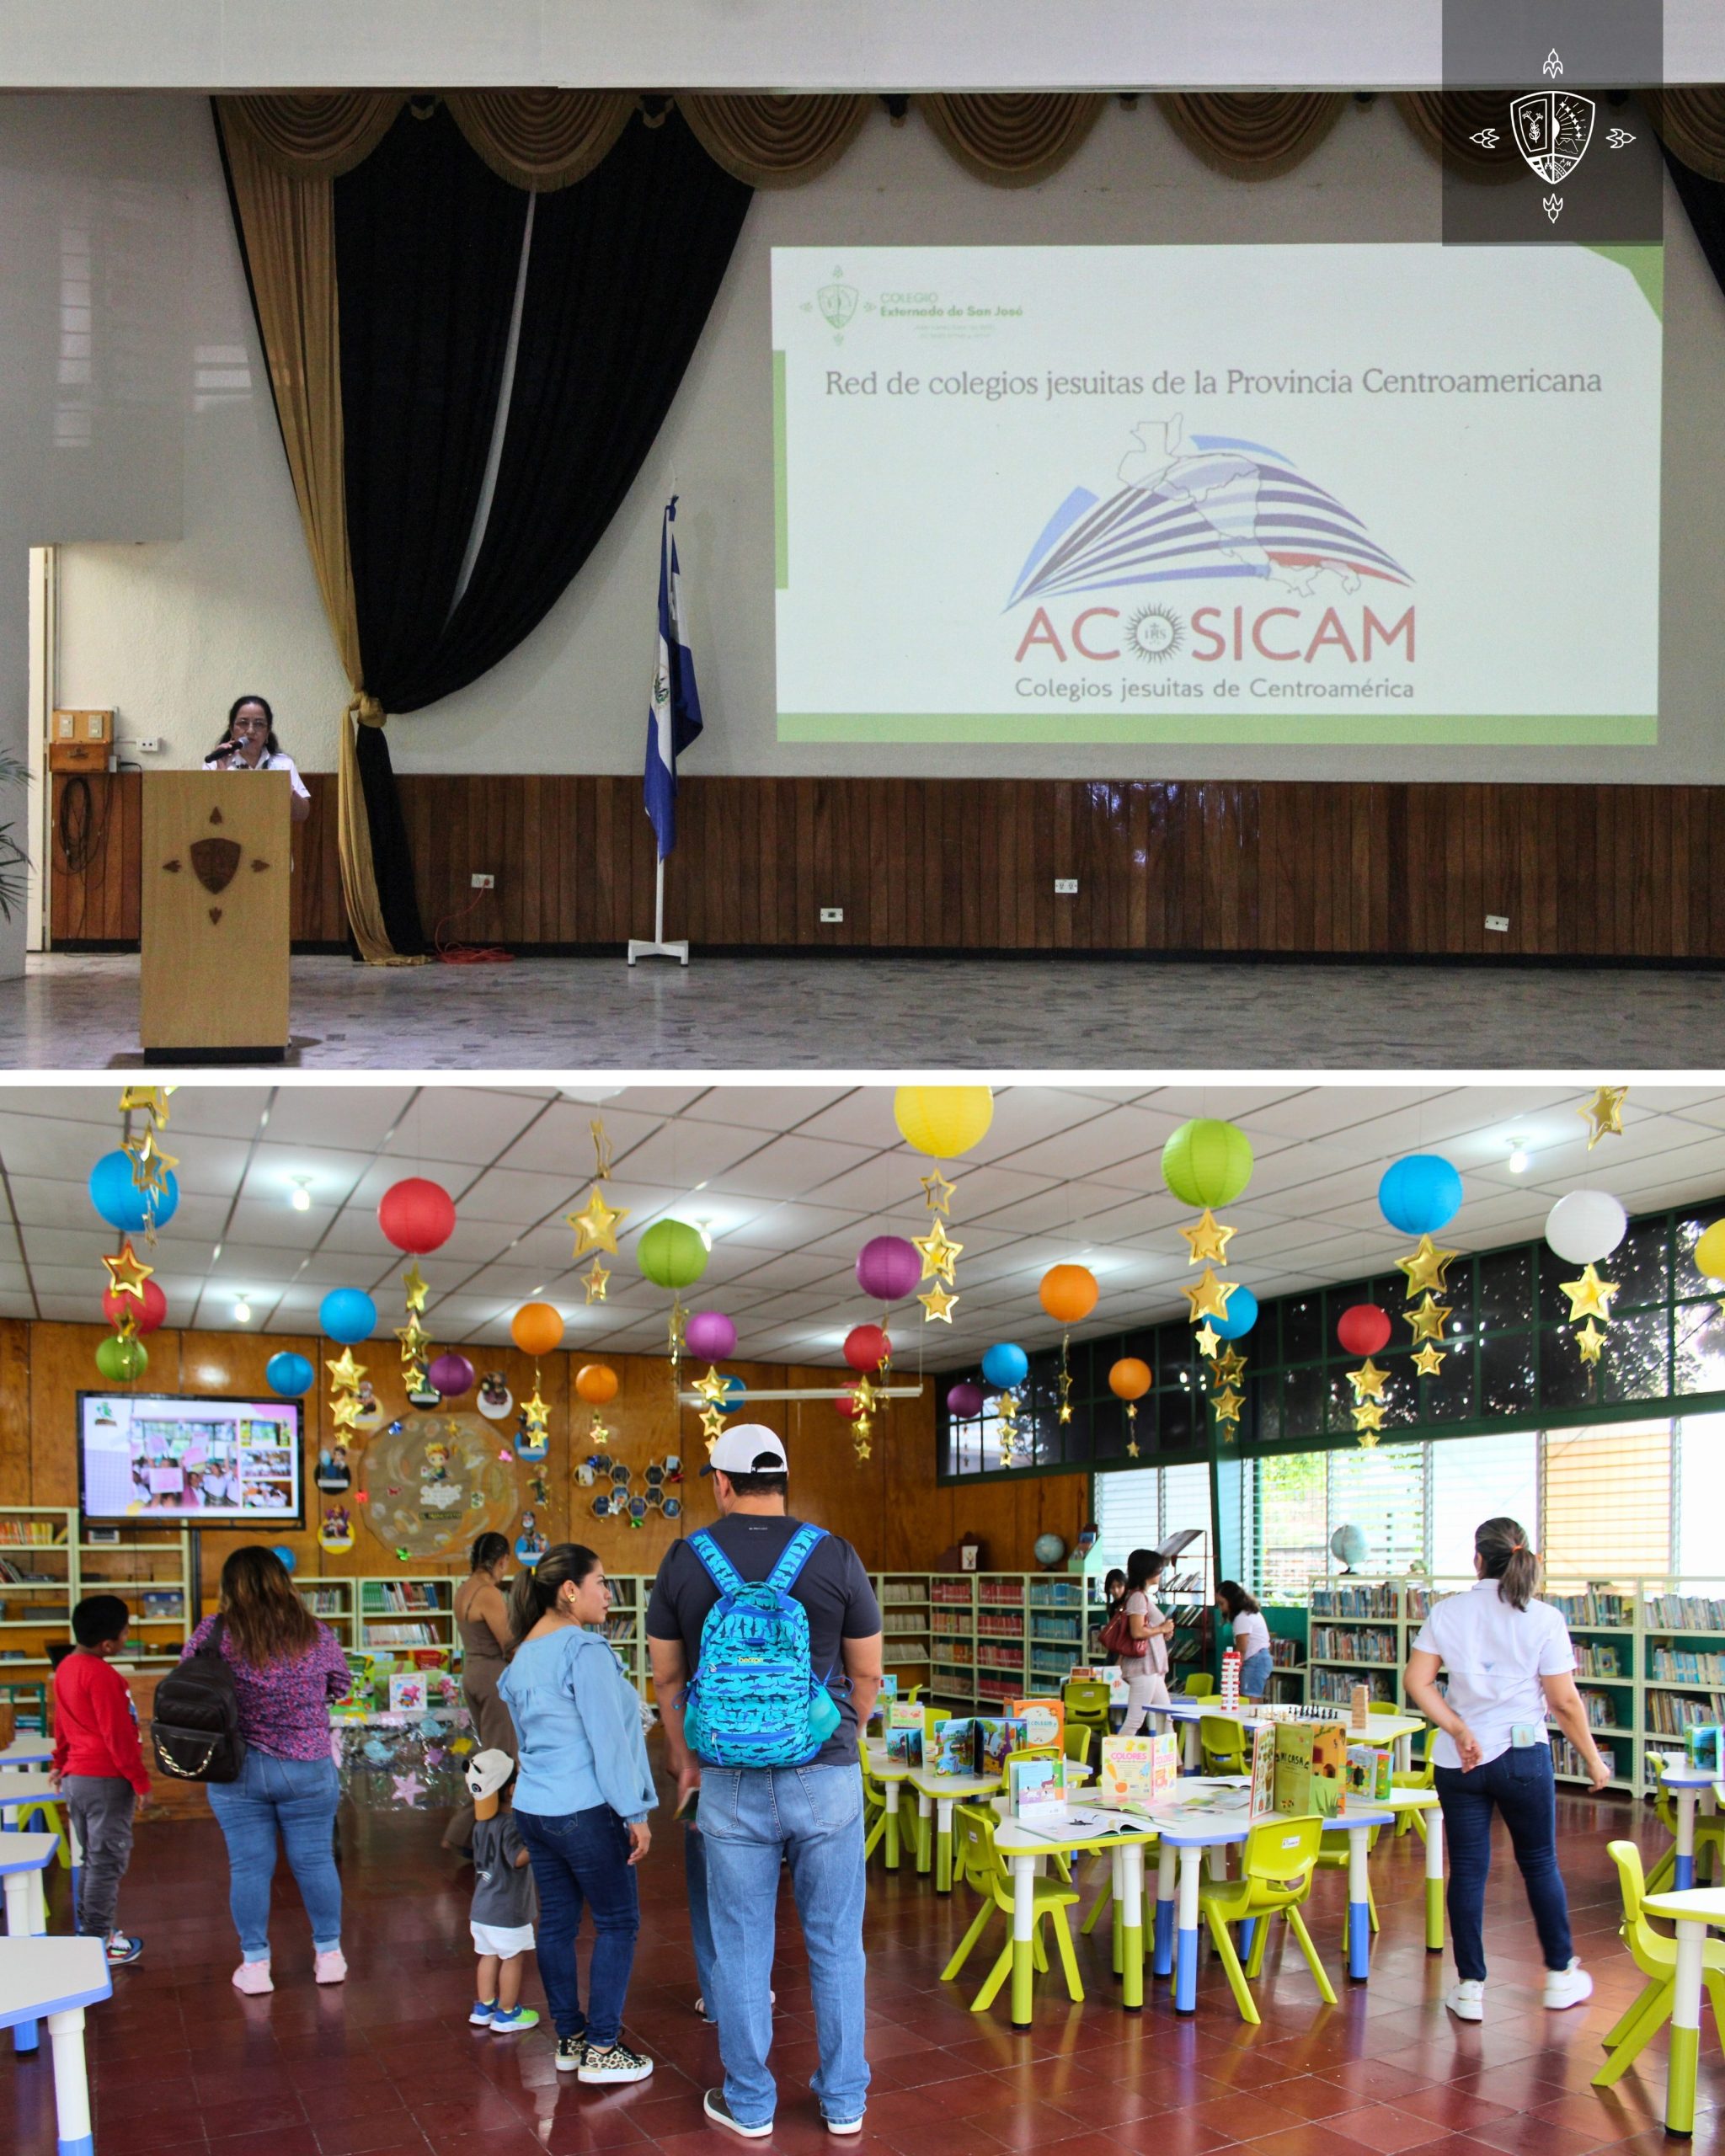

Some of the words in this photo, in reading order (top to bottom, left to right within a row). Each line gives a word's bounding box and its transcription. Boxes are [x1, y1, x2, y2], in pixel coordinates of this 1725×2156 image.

[880, 292, 939, 304] COLEGIO
[880, 305, 944, 318] Externado
[948, 305, 964, 317] de
[967, 305, 991, 317] San
[995, 304, 1023, 317] José
[825, 371, 878, 396] Red
[886, 371, 921, 396] de
[928, 371, 1039, 402] colegios
[1045, 370, 1145, 402] jesuitas
[1151, 370, 1186, 395] de
[1194, 369, 1218, 394] la
[1226, 368, 1353, 394] Provincia
[1361, 367, 1603, 394] Centroamericana
[1014, 677, 1113, 702] Colegios
[1120, 677, 1204, 703] jesuitas
[1213, 678, 1241, 697] de
[1249, 677, 1414, 698] Centroamérica
[1110, 1752, 1147, 1760] COLORES
[1288, 1753, 1304, 1766] CASA
